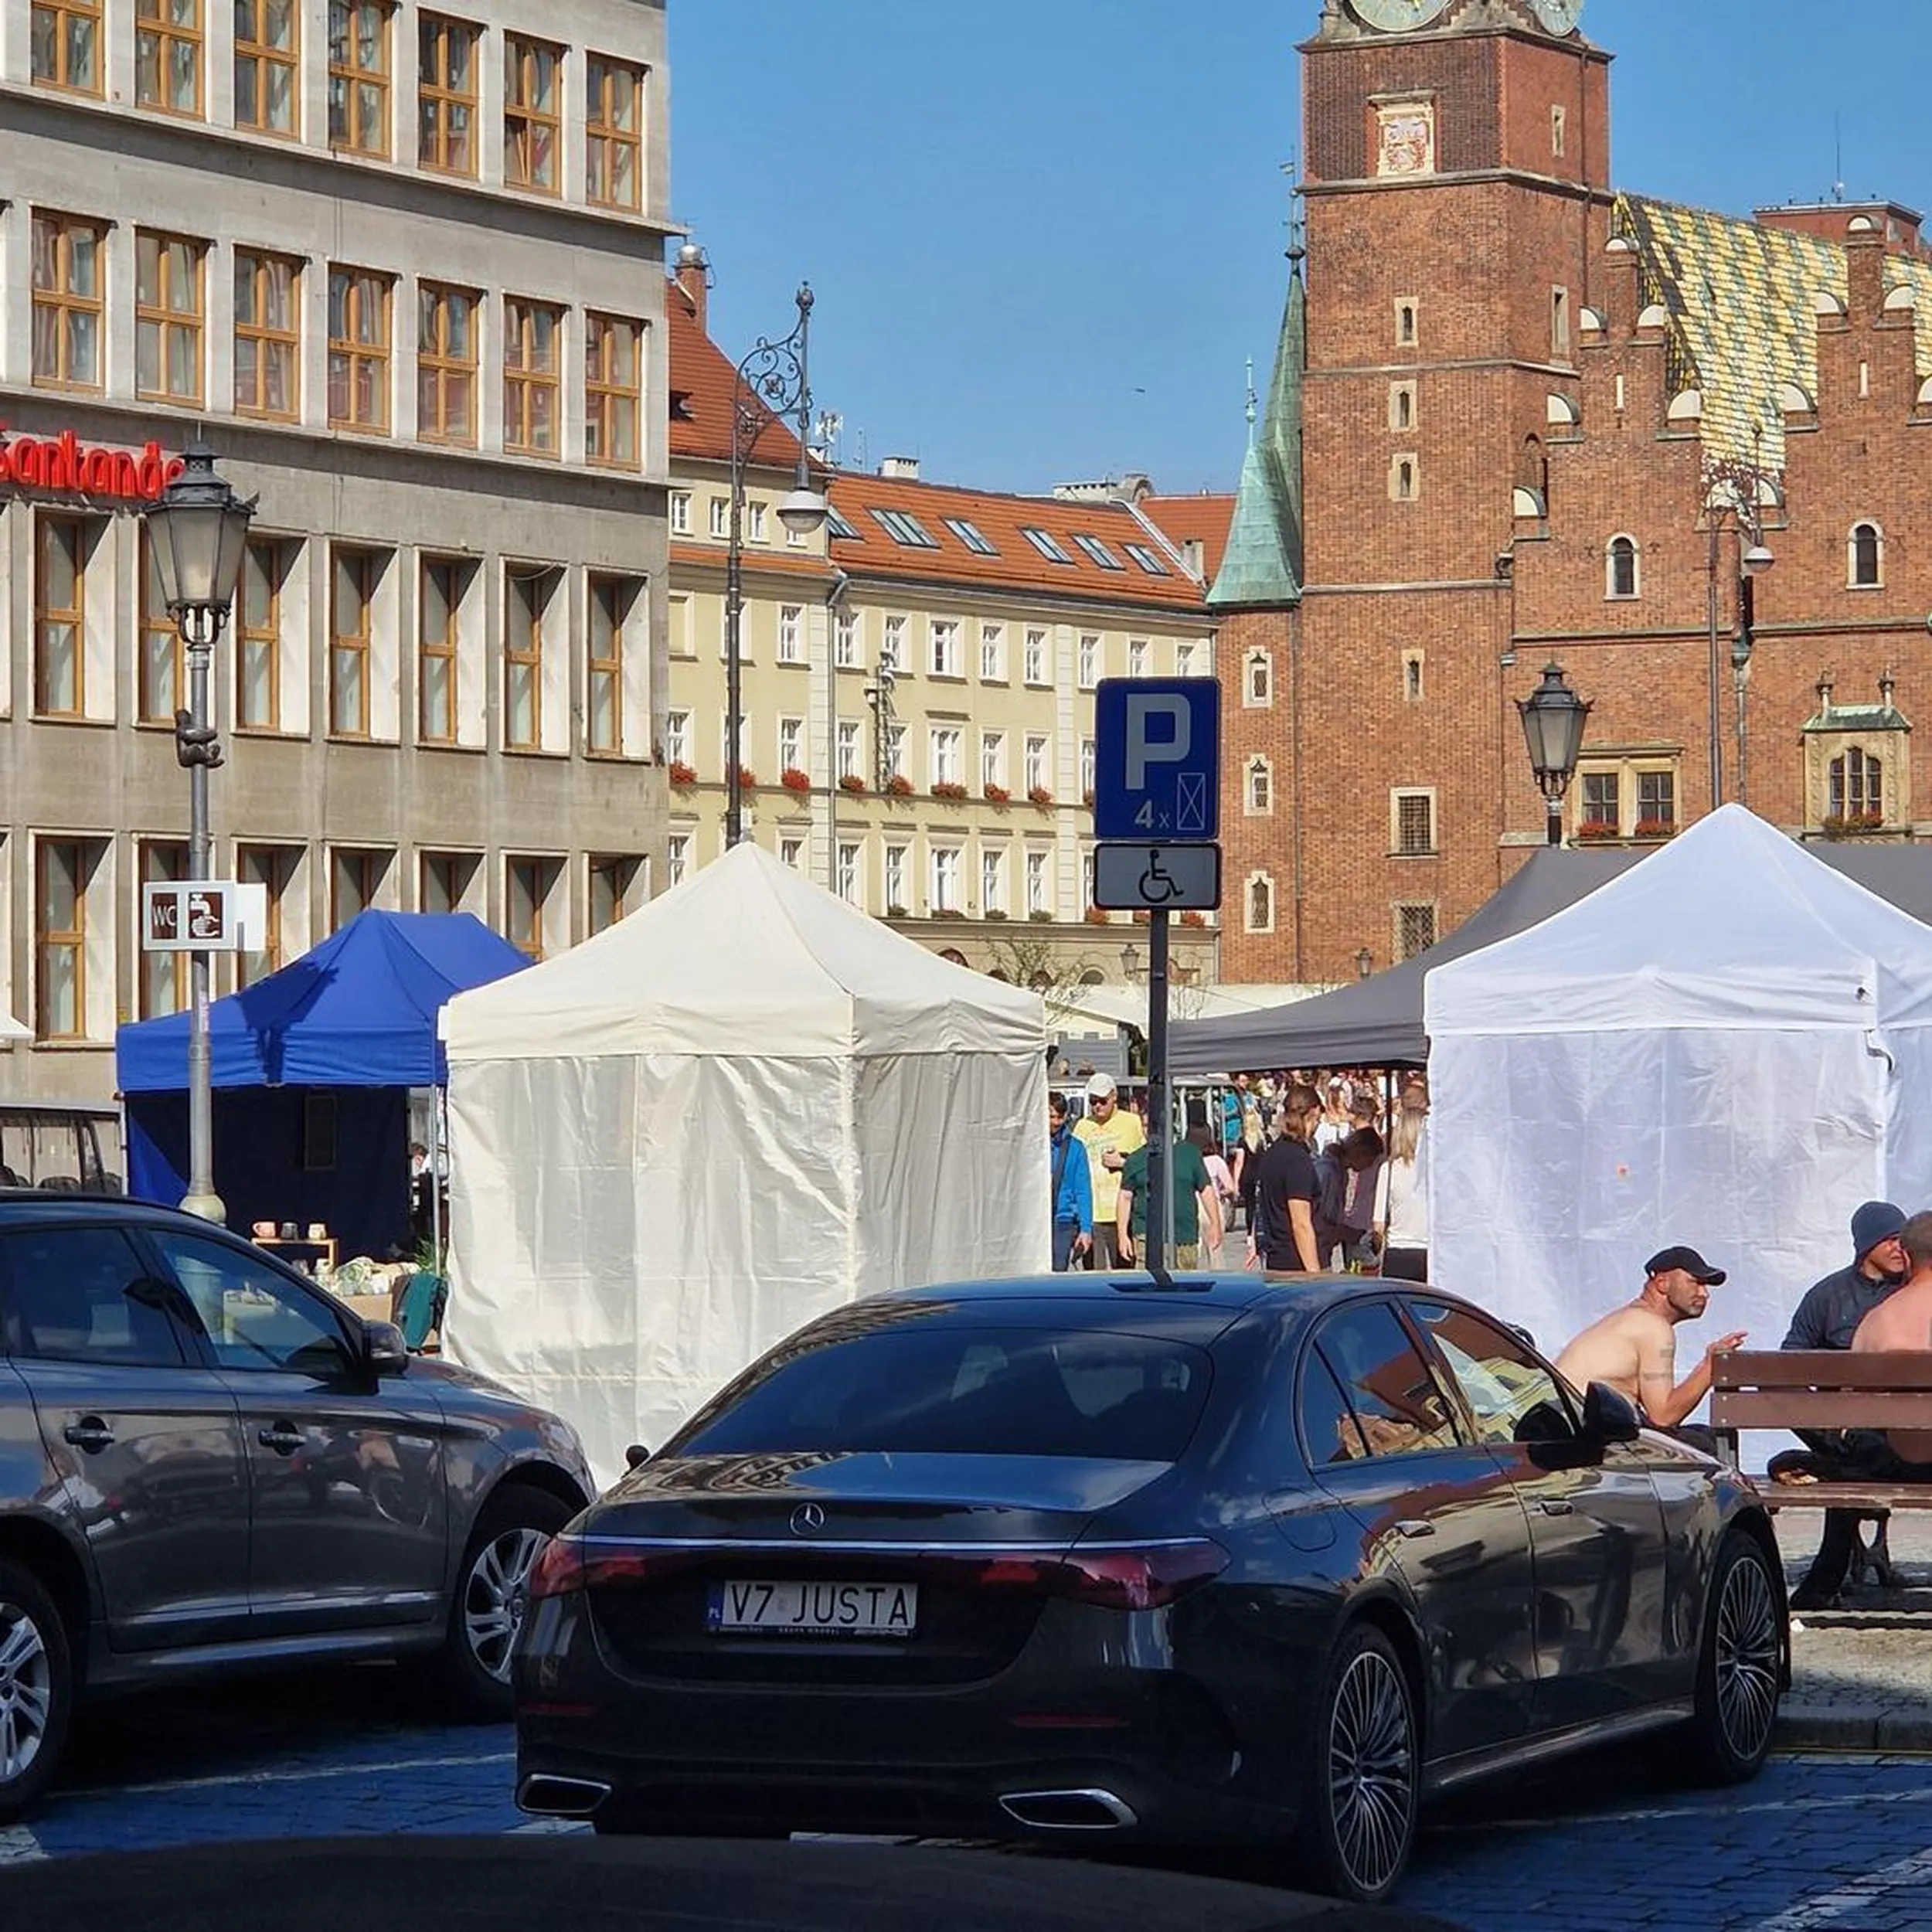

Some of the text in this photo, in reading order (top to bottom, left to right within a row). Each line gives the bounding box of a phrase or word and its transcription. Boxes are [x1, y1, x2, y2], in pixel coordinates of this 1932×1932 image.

[1125, 694, 1191, 790] P
[152, 906, 176, 926] WC
[731, 1584, 909, 1626] V7 JUSTA
